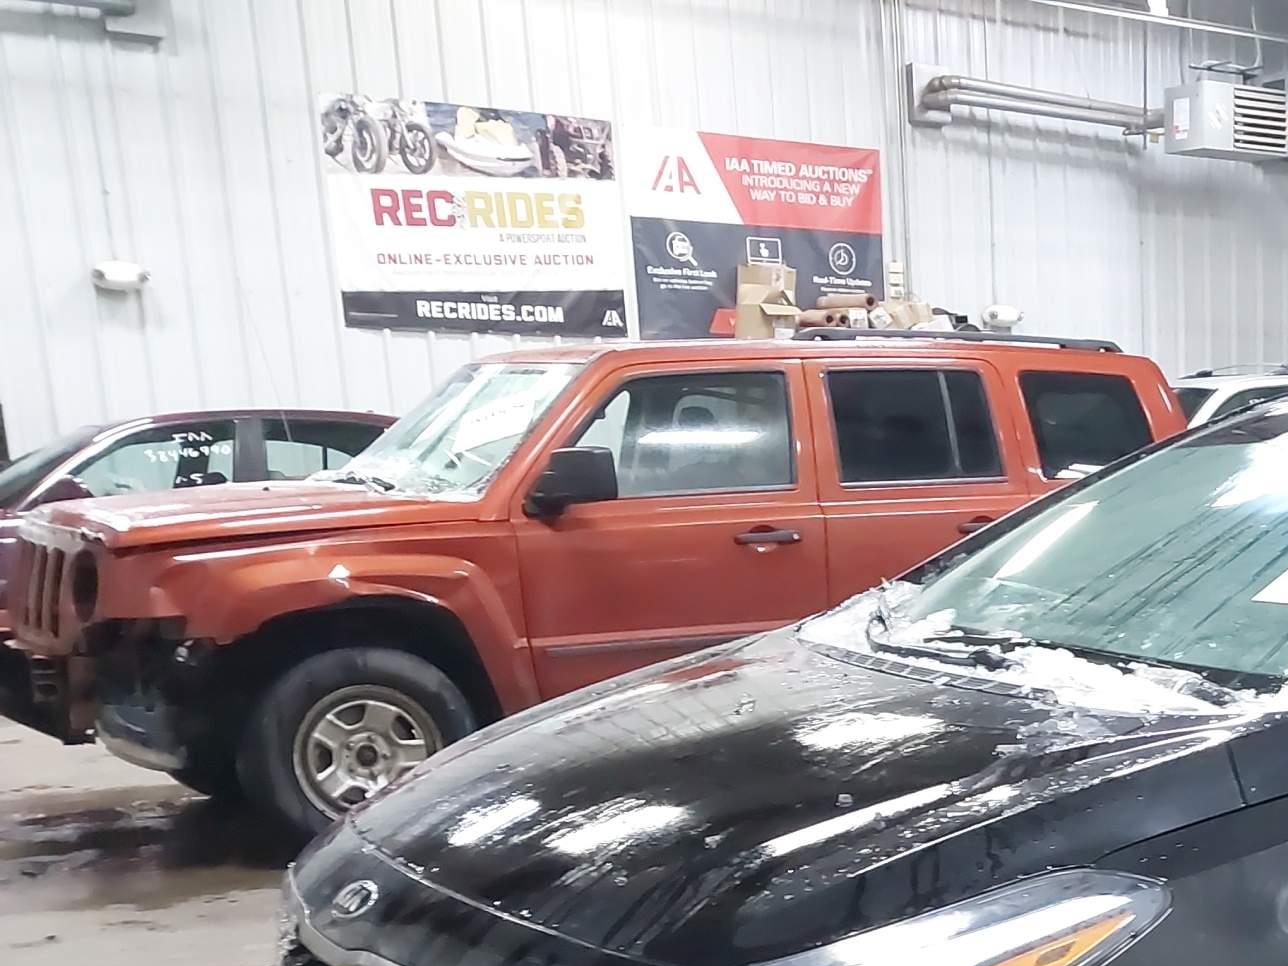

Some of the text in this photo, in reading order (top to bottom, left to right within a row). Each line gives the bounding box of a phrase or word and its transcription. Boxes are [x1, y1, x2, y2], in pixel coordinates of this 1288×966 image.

[725, 157, 750, 172] IAA
[751, 160, 796, 177] TIMED
[742, 174, 860, 196] INTRODUCING A NEW
[750, 188, 855, 208] WAY TO BID & BUY
[377, 253, 594, 266] ONLINE-EXCLUSIVE AUCTION
[416, 300, 565, 323] RECRIDES.COM
